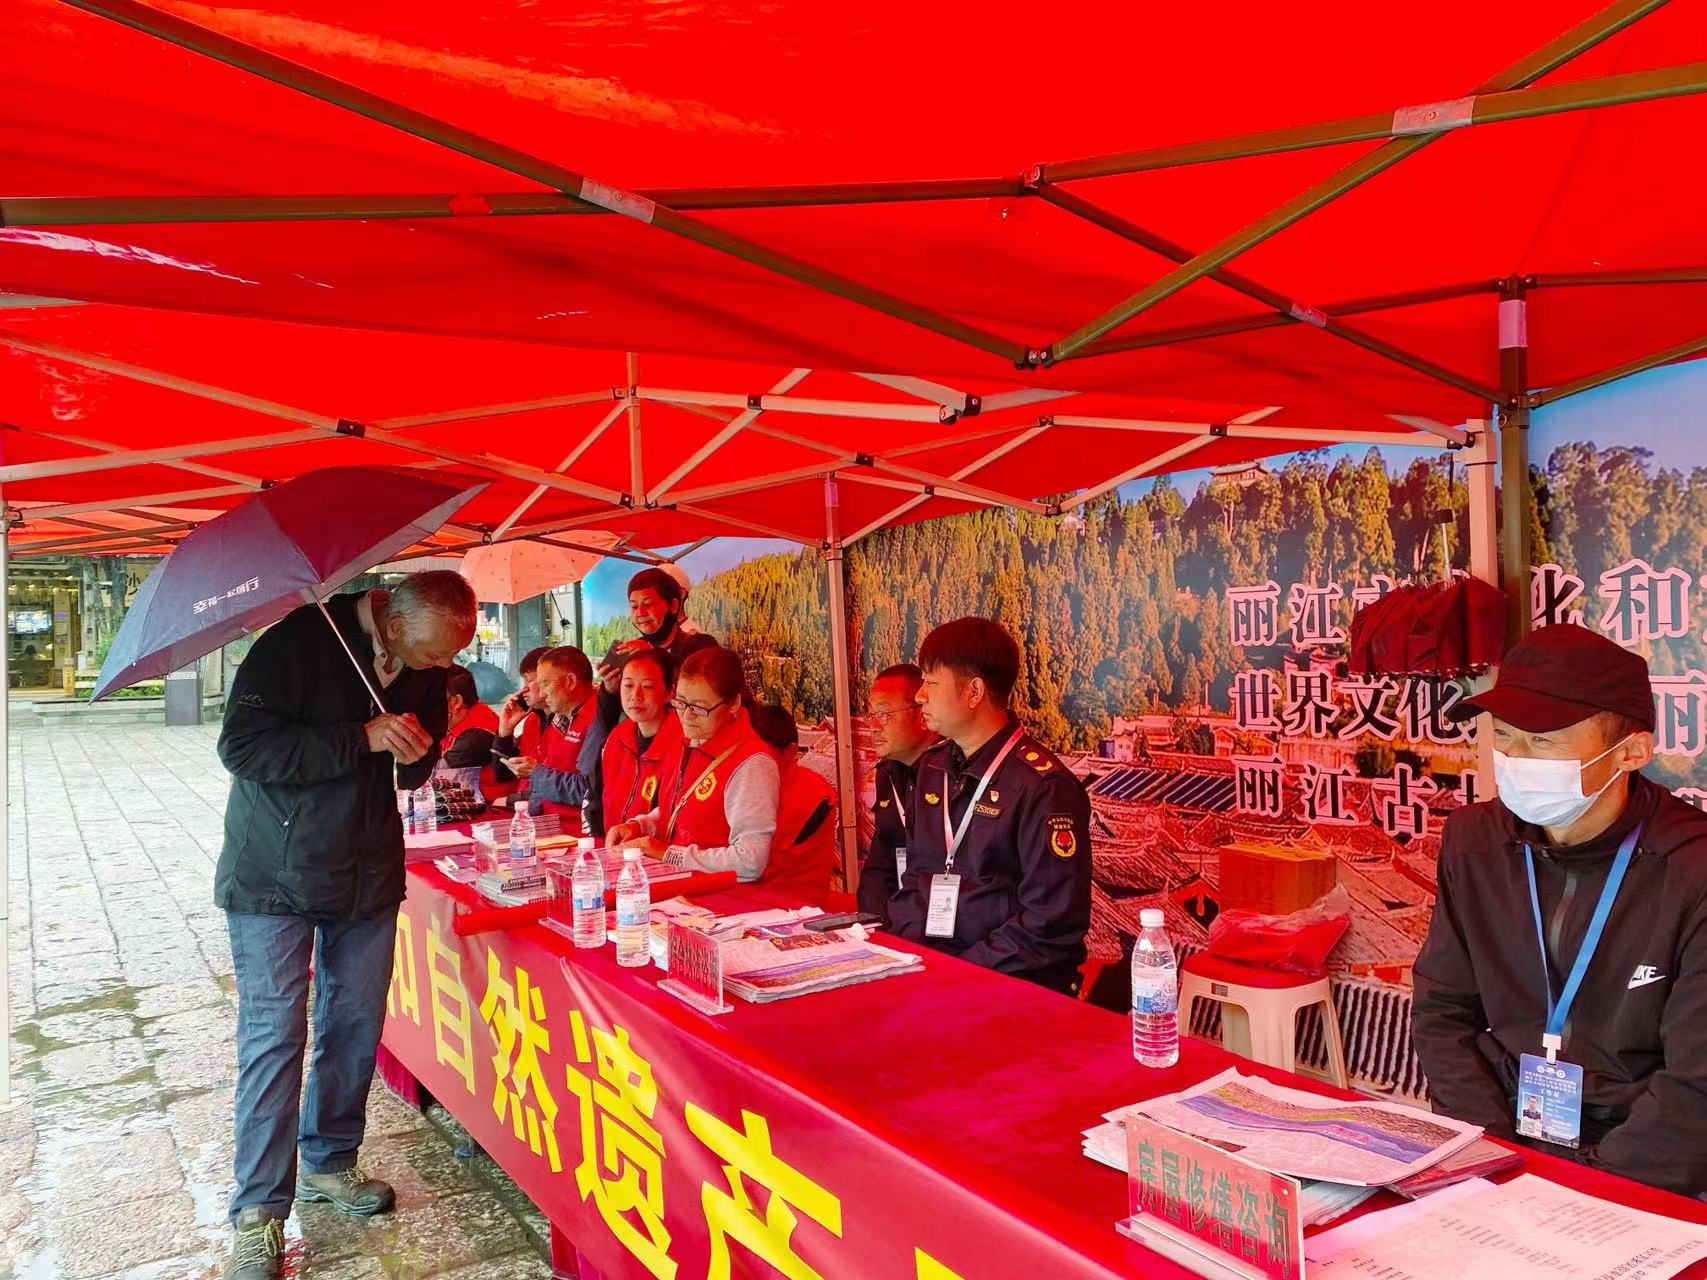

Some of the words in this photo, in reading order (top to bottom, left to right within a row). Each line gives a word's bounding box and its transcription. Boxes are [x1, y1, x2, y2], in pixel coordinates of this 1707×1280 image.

[1230, 754, 1478, 840] 丽江古
[1138, 1138, 1292, 1280] 房屋修缮咨询
